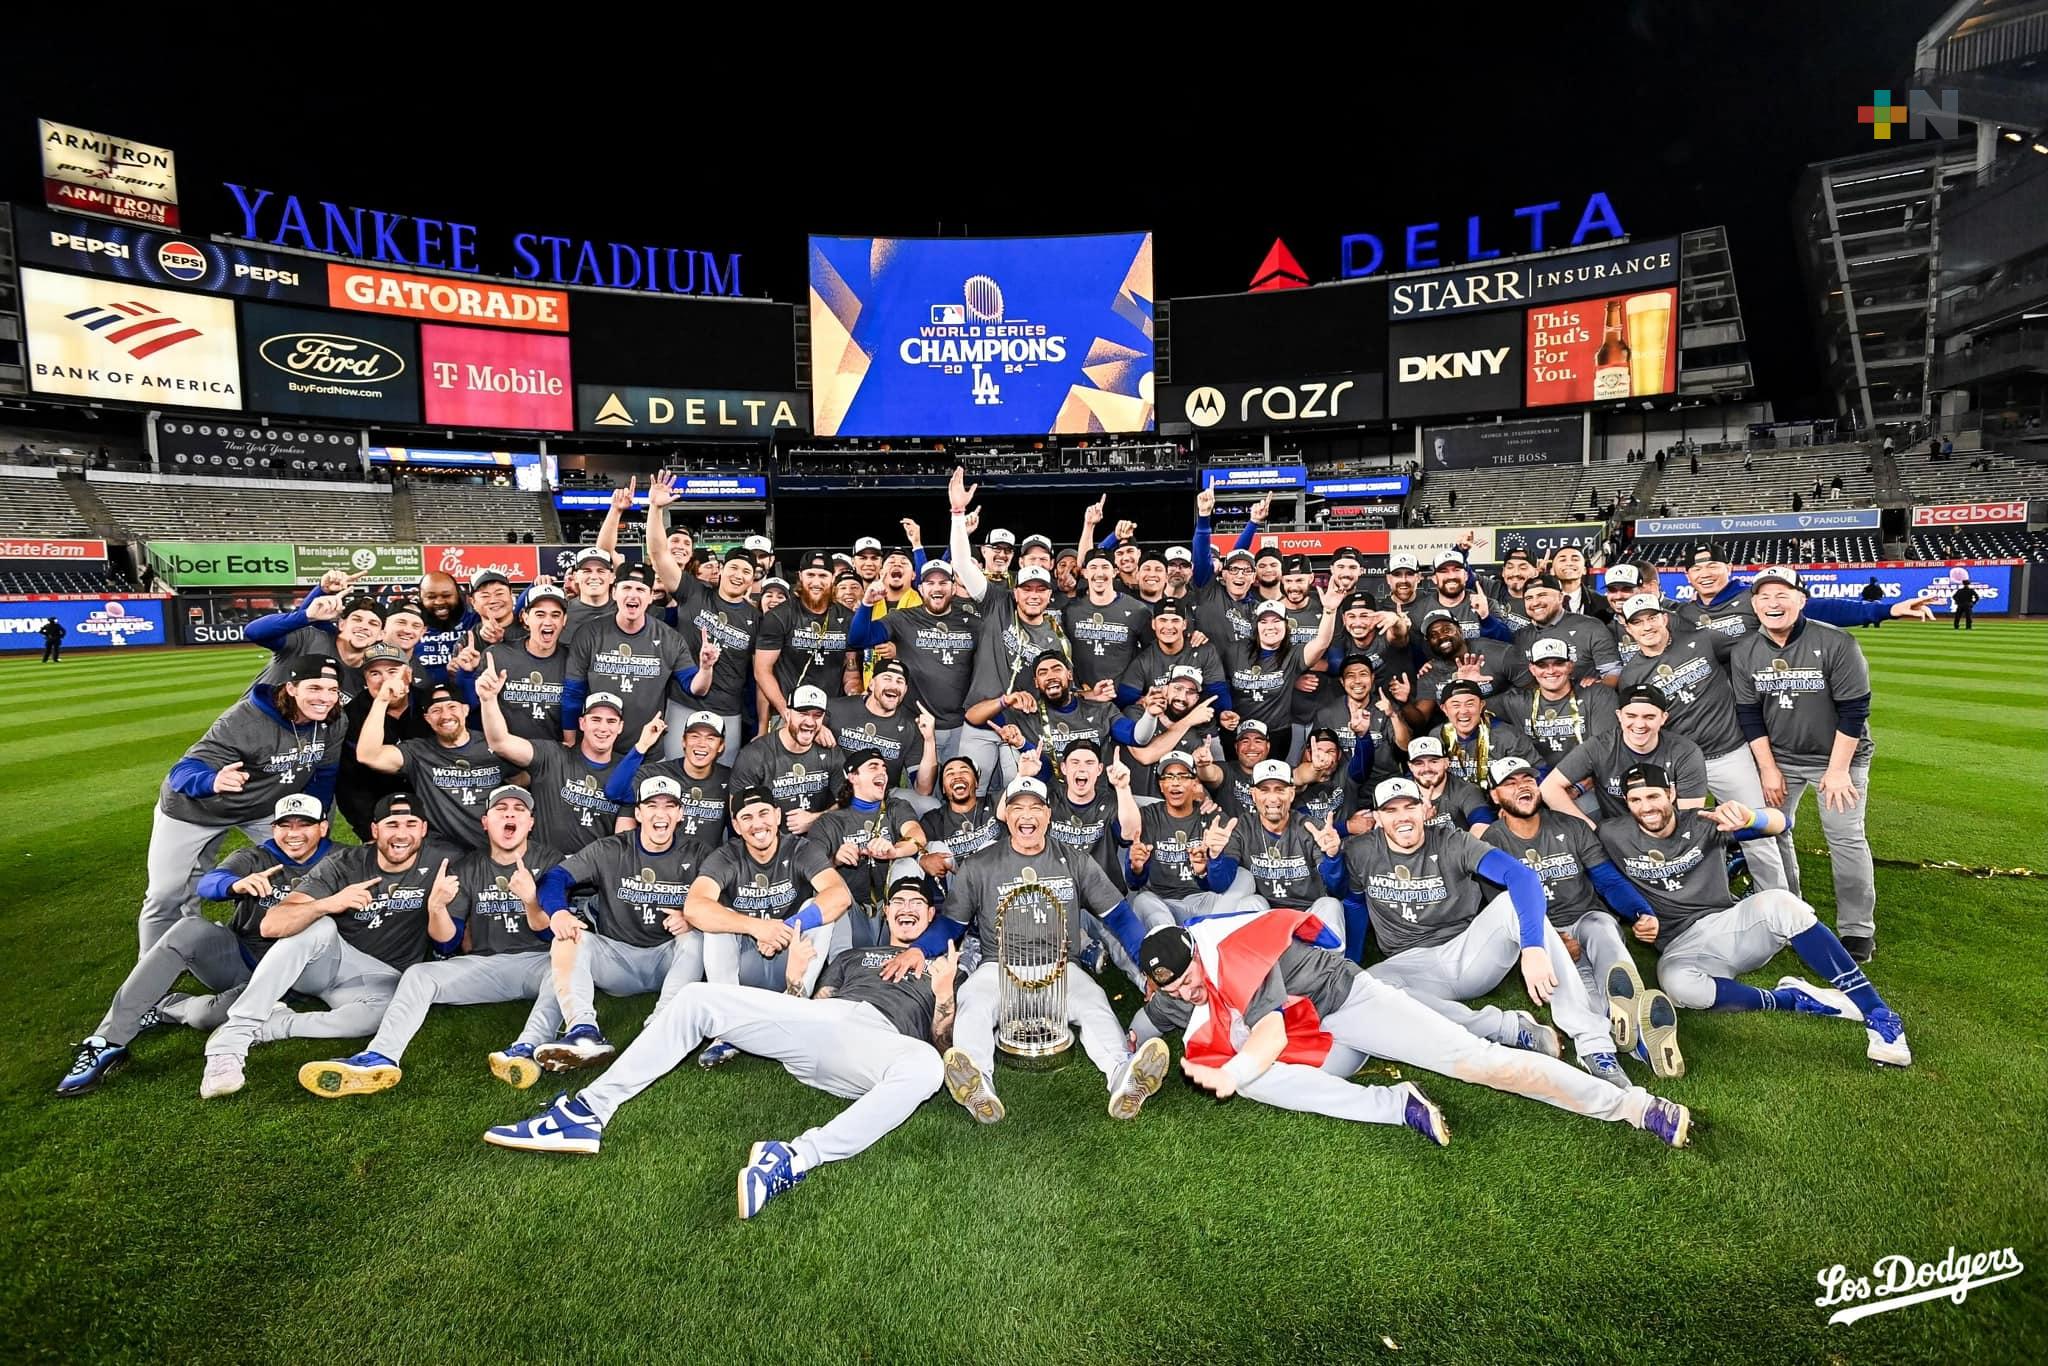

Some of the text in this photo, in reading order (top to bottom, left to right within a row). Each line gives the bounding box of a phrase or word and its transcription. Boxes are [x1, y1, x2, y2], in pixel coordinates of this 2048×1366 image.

[48, 130, 169, 169] ARMITRON
[58, 184, 166, 216] ARMITRON
[113, 206, 166, 223] WATCHES
[223, 182, 744, 298] YANKEE STADIUM
[1341, 191, 1626, 278] DELTA
[50, 231, 130, 260] PEPSI
[162, 253, 204, 269] PEPSI
[234, 263, 299, 286] PEPSI
[1392, 252, 1673, 316] STARR INSURANCE
[344, 274, 559, 324] GATORADE
[1533, 311, 1581, 331] This
[919, 325, 1047, 337] WORLD SERIES
[1534, 327, 1590, 348] Bud's
[286, 338, 381, 377] Ford
[900, 336, 1066, 364] CHAMPIONS
[1534, 349, 1569, 366] For
[944, 364, 963, 375] 20
[1004, 363, 1024, 375] 24
[1398, 347, 1511, 384] DKNY
[35, 363, 235, 395] BANK OF AMERICA
[466, 364, 563, 396] Mobile
[1533, 366, 1578, 384] You.
[288, 381, 383, 398] BuyFordNow.com
[971, 363, 1000, 405] LA
[1240, 380, 1354, 422] razr
[648, 398, 797, 427] DELTA
[222, 440, 244, 450] New
[245, 442, 267, 455] York
[1492, 452, 1548, 464] THE BOSS
[1364, 505, 1399, 514] TERRACE
[1915, 504, 2024, 524] Reebok
[628, 522, 648, 530] TERR
[1662, 522, 1702, 530] FANDUEL
[1735, 519, 1778, 528] FANDUEL
[1813, 515, 1860, 524] FANDUEL
[375, 546, 419, 556] Workmen's
[1281, 540, 1322, 549] TOYOTA
[1392, 543, 1416, 551] BANK
[1536, 536, 1596, 550] CLEAR
[298, 546, 350, 557] Morningside
[226, 555, 289, 574] Eats
[395, 556, 419, 565] Circle
[1810, 583, 1902, 599] CHAMPNS
[76, 621, 154, 633] CHAMPIONS
[194, 626, 244, 641] Stub
[700, 610, 751, 642] WORLD SERIES
[1075, 622, 1129, 633] WORLD SERIES
[794, 629, 846, 641] WORLD SERIES
[917, 630, 972, 641] WORLD SERIES
[1075, 629, 1128, 642] CHAMPIONS
[916, 638, 973, 649] CHAMPIONS
[1093, 640, 1105, 656] LA
[595, 654, 660, 666] WORLD SERIES
[941, 649, 954, 665] LA
[593, 663, 660, 677] CHAMPIONS
[1259, 670, 1283, 681] SERIES
[1675, 657, 1709, 681] SERIES
[1788, 670, 1823, 680] SERIES
[505, 682, 540, 693] WORLD
[619, 675, 633, 692] LA
[1677, 687, 1696, 704] LA
[1777, 690, 1795, 709] LA
[533, 702, 545, 720] LA
[841, 728, 901, 750] WORLD SERIES
[1070, 729, 1099, 741] SERIES
[432, 765, 500, 778] WORLD SERIES
[773, 771, 828, 787] WORLD SERIES
[432, 774, 501, 787] CHAMPIONS
[772, 780, 828, 797] CHAMPIONS
[462, 787, 476, 805] LA
[560, 786, 620, 814] CHAMPIONS
[699, 800, 725, 809] SERIES
[580, 807, 593, 827] LA
[1051, 821, 1081, 835] WORLD
[1051, 829, 1103, 843] CHAMPIONS
[843, 834, 872, 845] WORLD
[944, 832, 976, 847] WORLD
[1156, 840, 1186, 851] WORLD
[1250, 856, 1306, 868] WORLD SERIES
[1541, 854, 1575, 870] SERIES
[1623, 846, 1702, 869] WORLD SERIES
[1250, 865, 1309, 880] CHAMPIONS
[1625, 854, 1703, 879] CHAMPIONS
[653, 883, 690, 894] SERIES
[765, 881, 793, 896] SERIES
[1272, 879, 1287, 897] LA
[1368, 876, 1444, 890] WORLD SERIES
[1662, 877, 1683, 891] LA
[733, 889, 798, 908] CHAMPIONS
[1367, 886, 1447, 903] CHAMPIONS
[642, 903, 656, 924] LA
[1401, 902, 1418, 923] LA
[503, 913, 519, 933] LA
